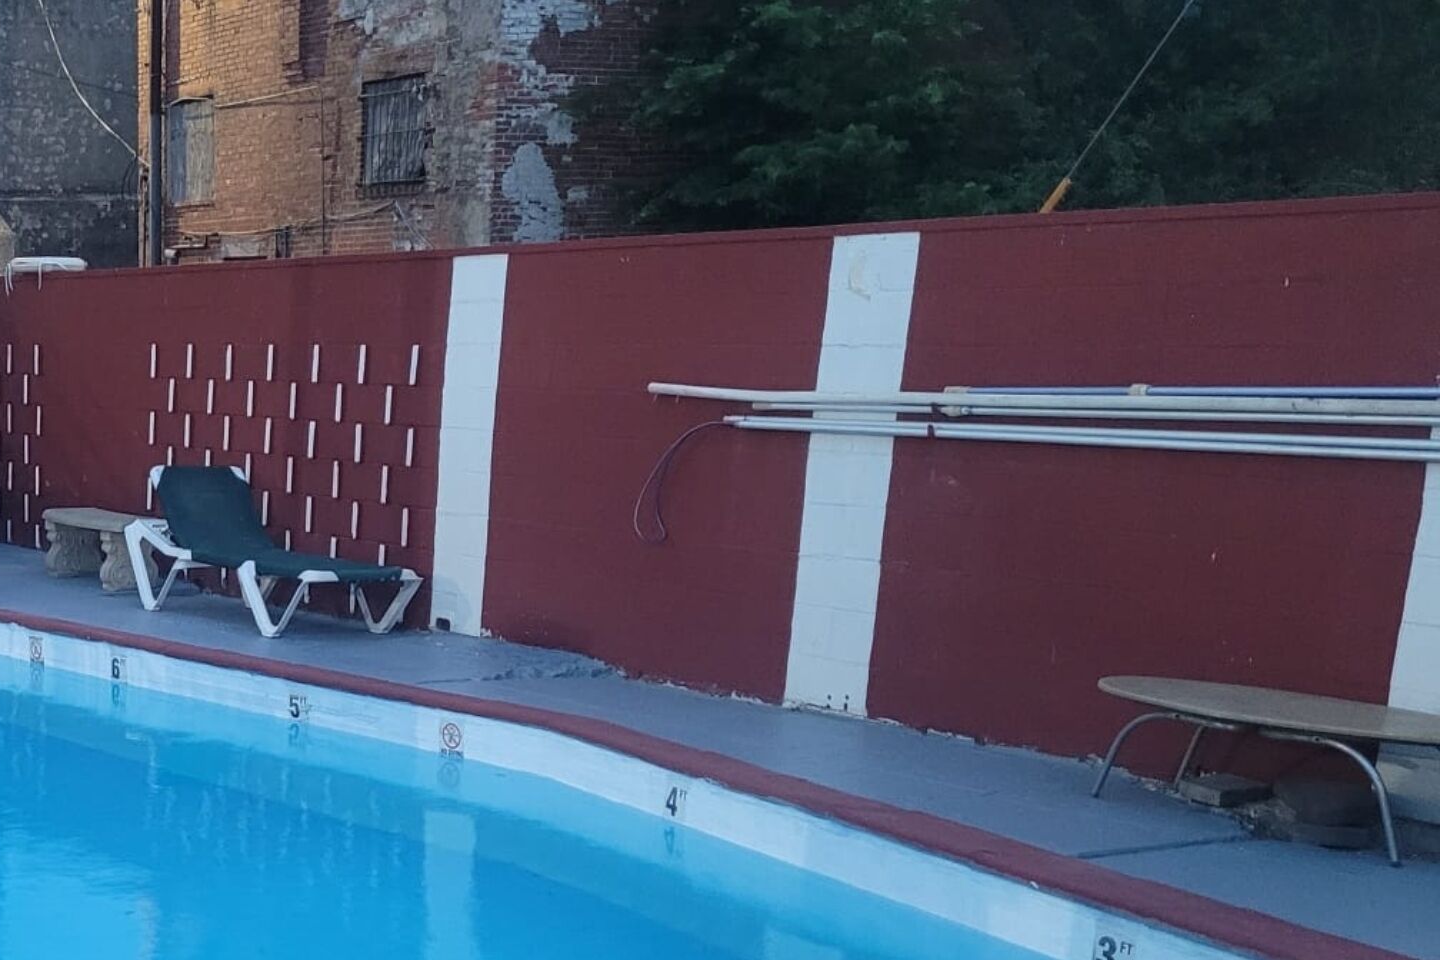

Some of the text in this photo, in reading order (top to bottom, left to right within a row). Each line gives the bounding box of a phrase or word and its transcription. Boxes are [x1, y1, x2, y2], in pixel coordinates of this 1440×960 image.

[111, 657, 120, 680] 6
[290, 695, 299, 718] 5
[665, 786, 678, 817] 4
[1119, 941, 1135, 956] FT
